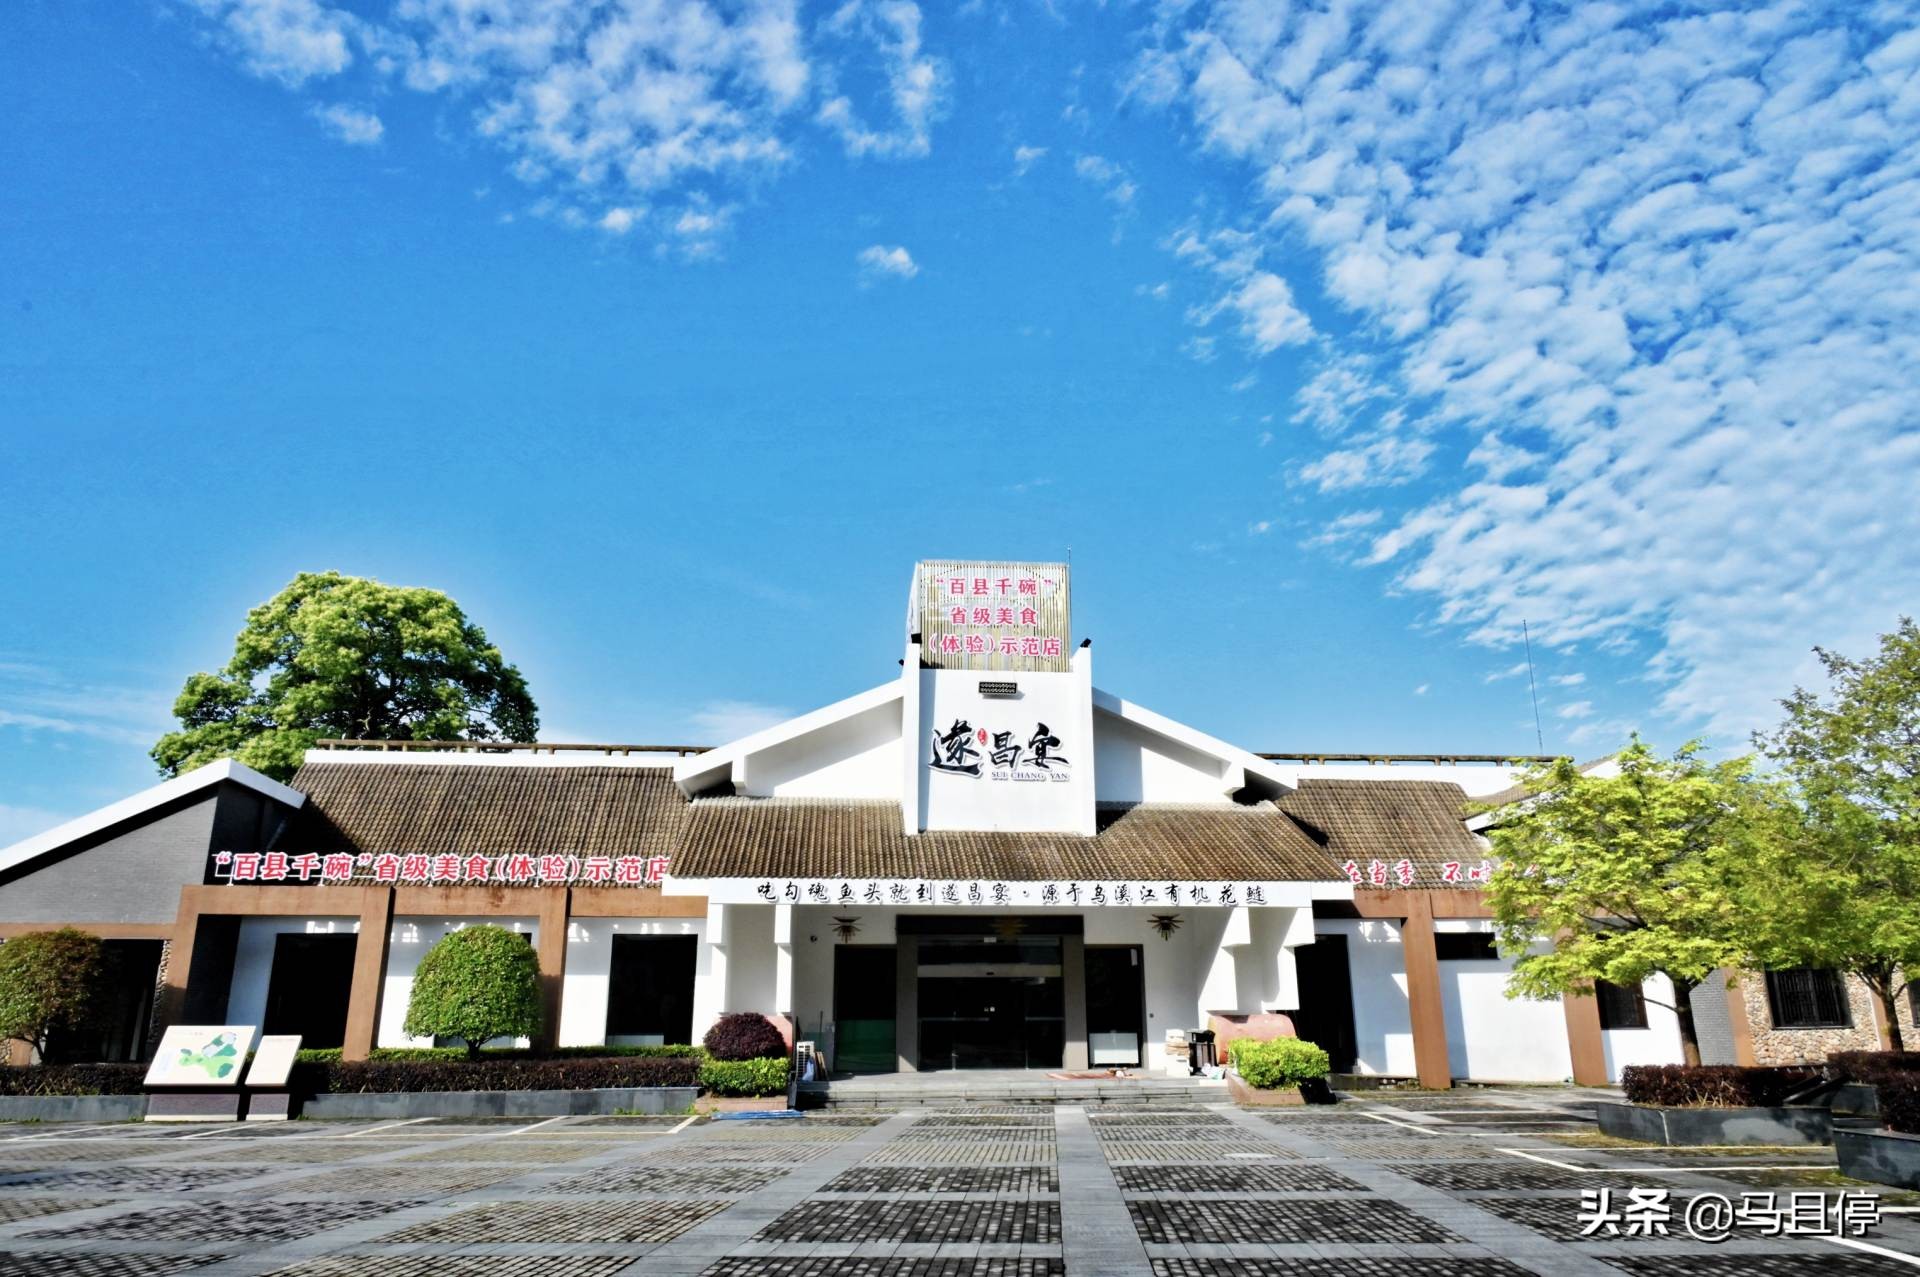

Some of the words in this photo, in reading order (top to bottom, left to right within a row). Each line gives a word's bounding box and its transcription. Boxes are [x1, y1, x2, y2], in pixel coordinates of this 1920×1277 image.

[950, 606, 1038, 626] 省级美食
[929, 719, 1070, 776] 遂昌宴
[1011, 771, 1045, 780] CHANG
[1050, 772, 1069, 781] YAN
